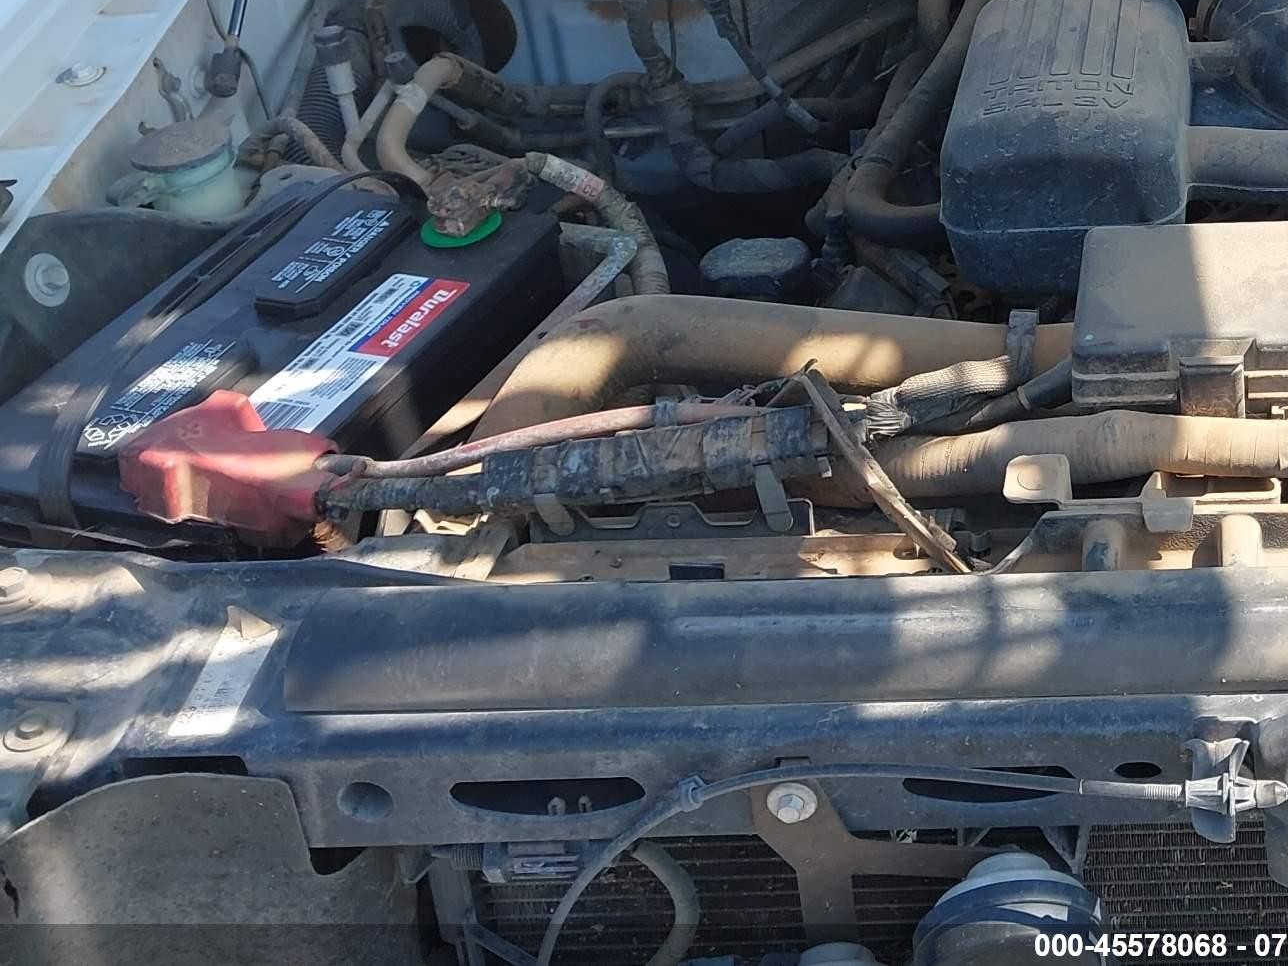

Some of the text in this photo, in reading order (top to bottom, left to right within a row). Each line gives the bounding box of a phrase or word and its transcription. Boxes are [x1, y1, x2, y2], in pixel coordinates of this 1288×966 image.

[983, 79, 1134, 100] TRITON
[982, 95, 1129, 116] 5.4L 3V
[348, 227, 385, 253] DANGER
[314, 257, 348, 283] POISON
[380, 289, 458, 349] Duralast
